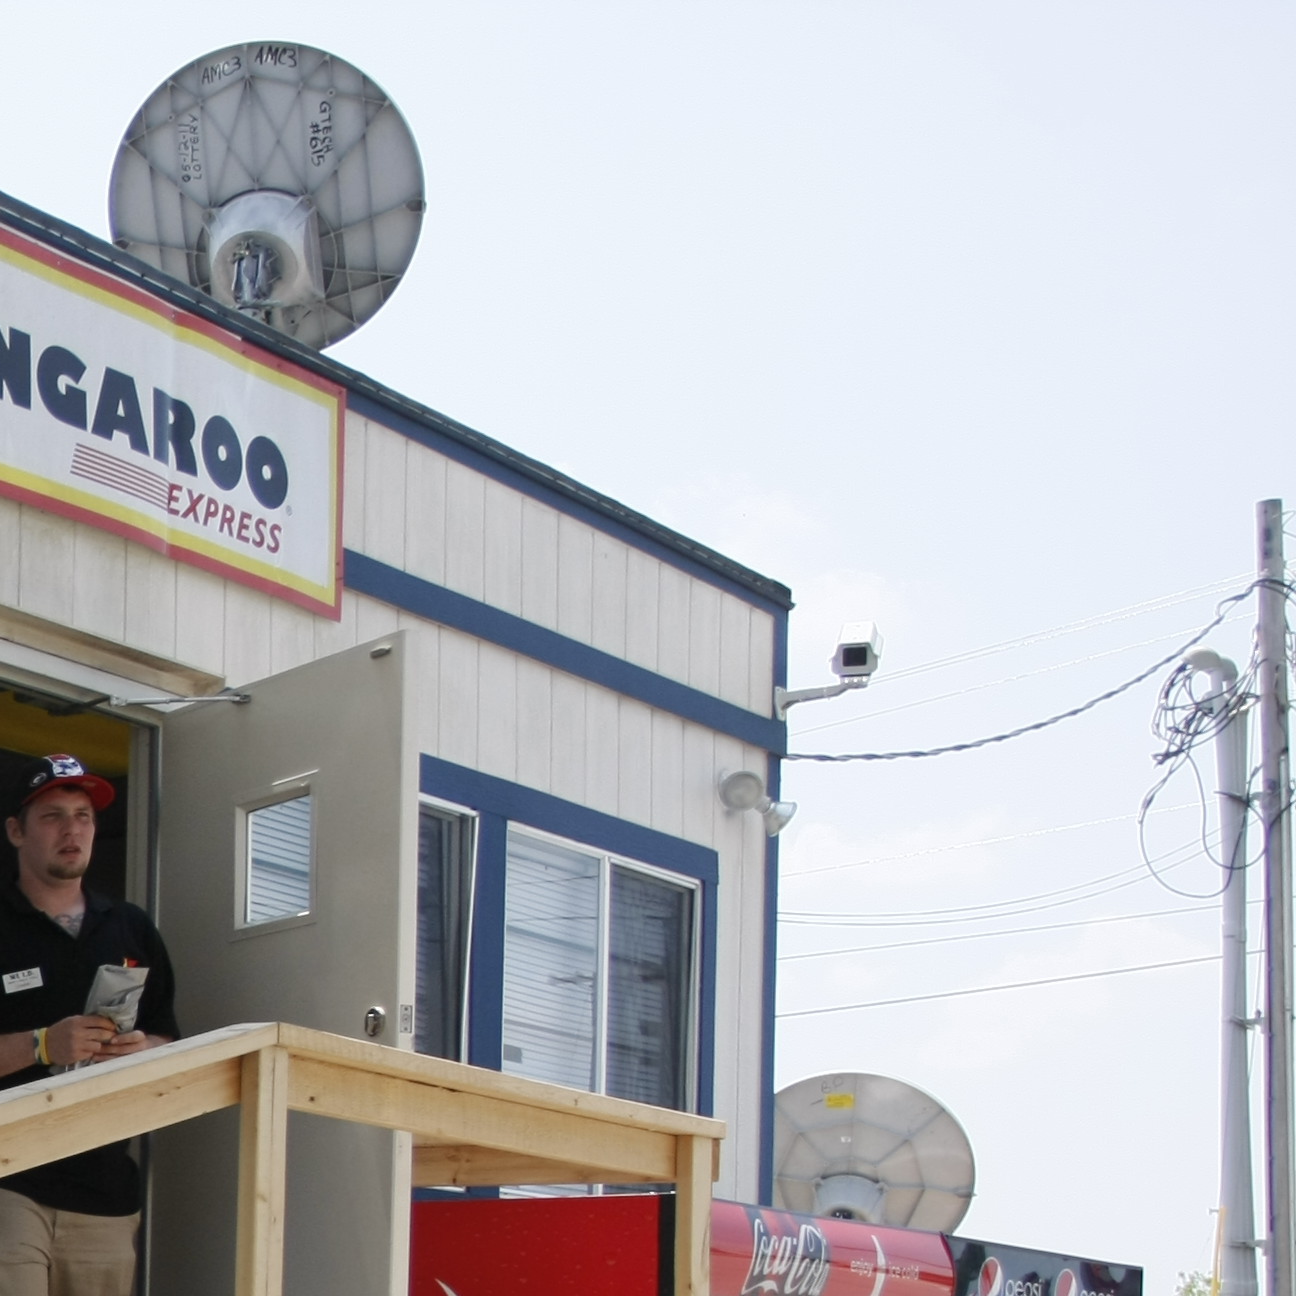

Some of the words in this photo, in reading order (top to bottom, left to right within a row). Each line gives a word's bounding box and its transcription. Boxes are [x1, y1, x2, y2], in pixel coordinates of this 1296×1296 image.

[200, 55, 242, 85] AMC3
[253, 45, 298, 68] AMC3
[189, 113, 202, 180] LOTTERY
[308, 121, 326, 168] #615
[318, 100, 334, 153] GTECH
[167, 482, 283, 555] EXPRESS
[850, 1258, 874, 1278] enjoy
